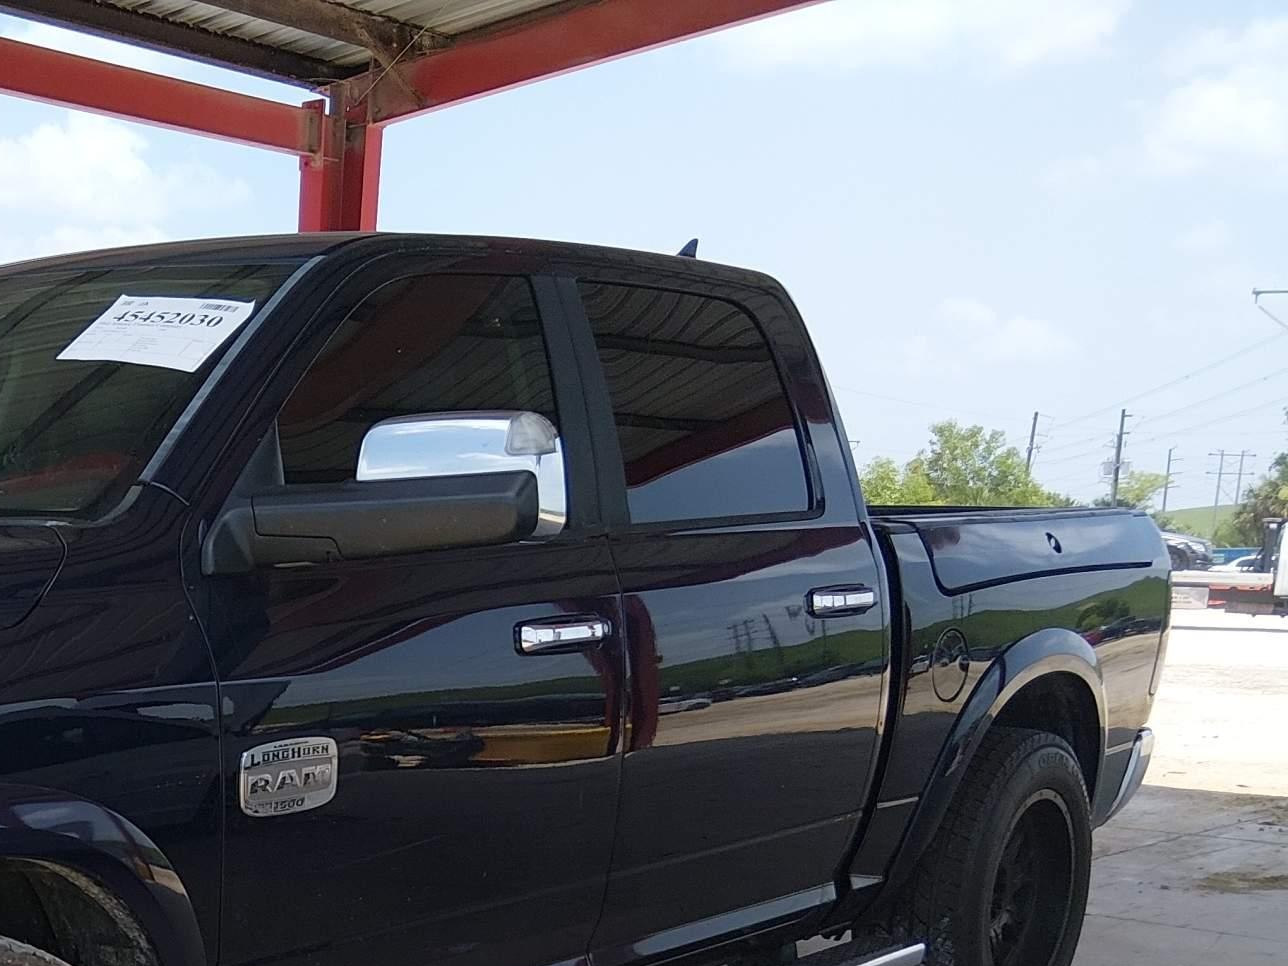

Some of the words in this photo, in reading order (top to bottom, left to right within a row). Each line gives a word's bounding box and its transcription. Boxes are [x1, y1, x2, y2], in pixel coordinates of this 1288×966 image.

[113, 310, 223, 328] 45452030
[248, 764, 331, 795] RAM
[273, 797, 305, 811] 1500
